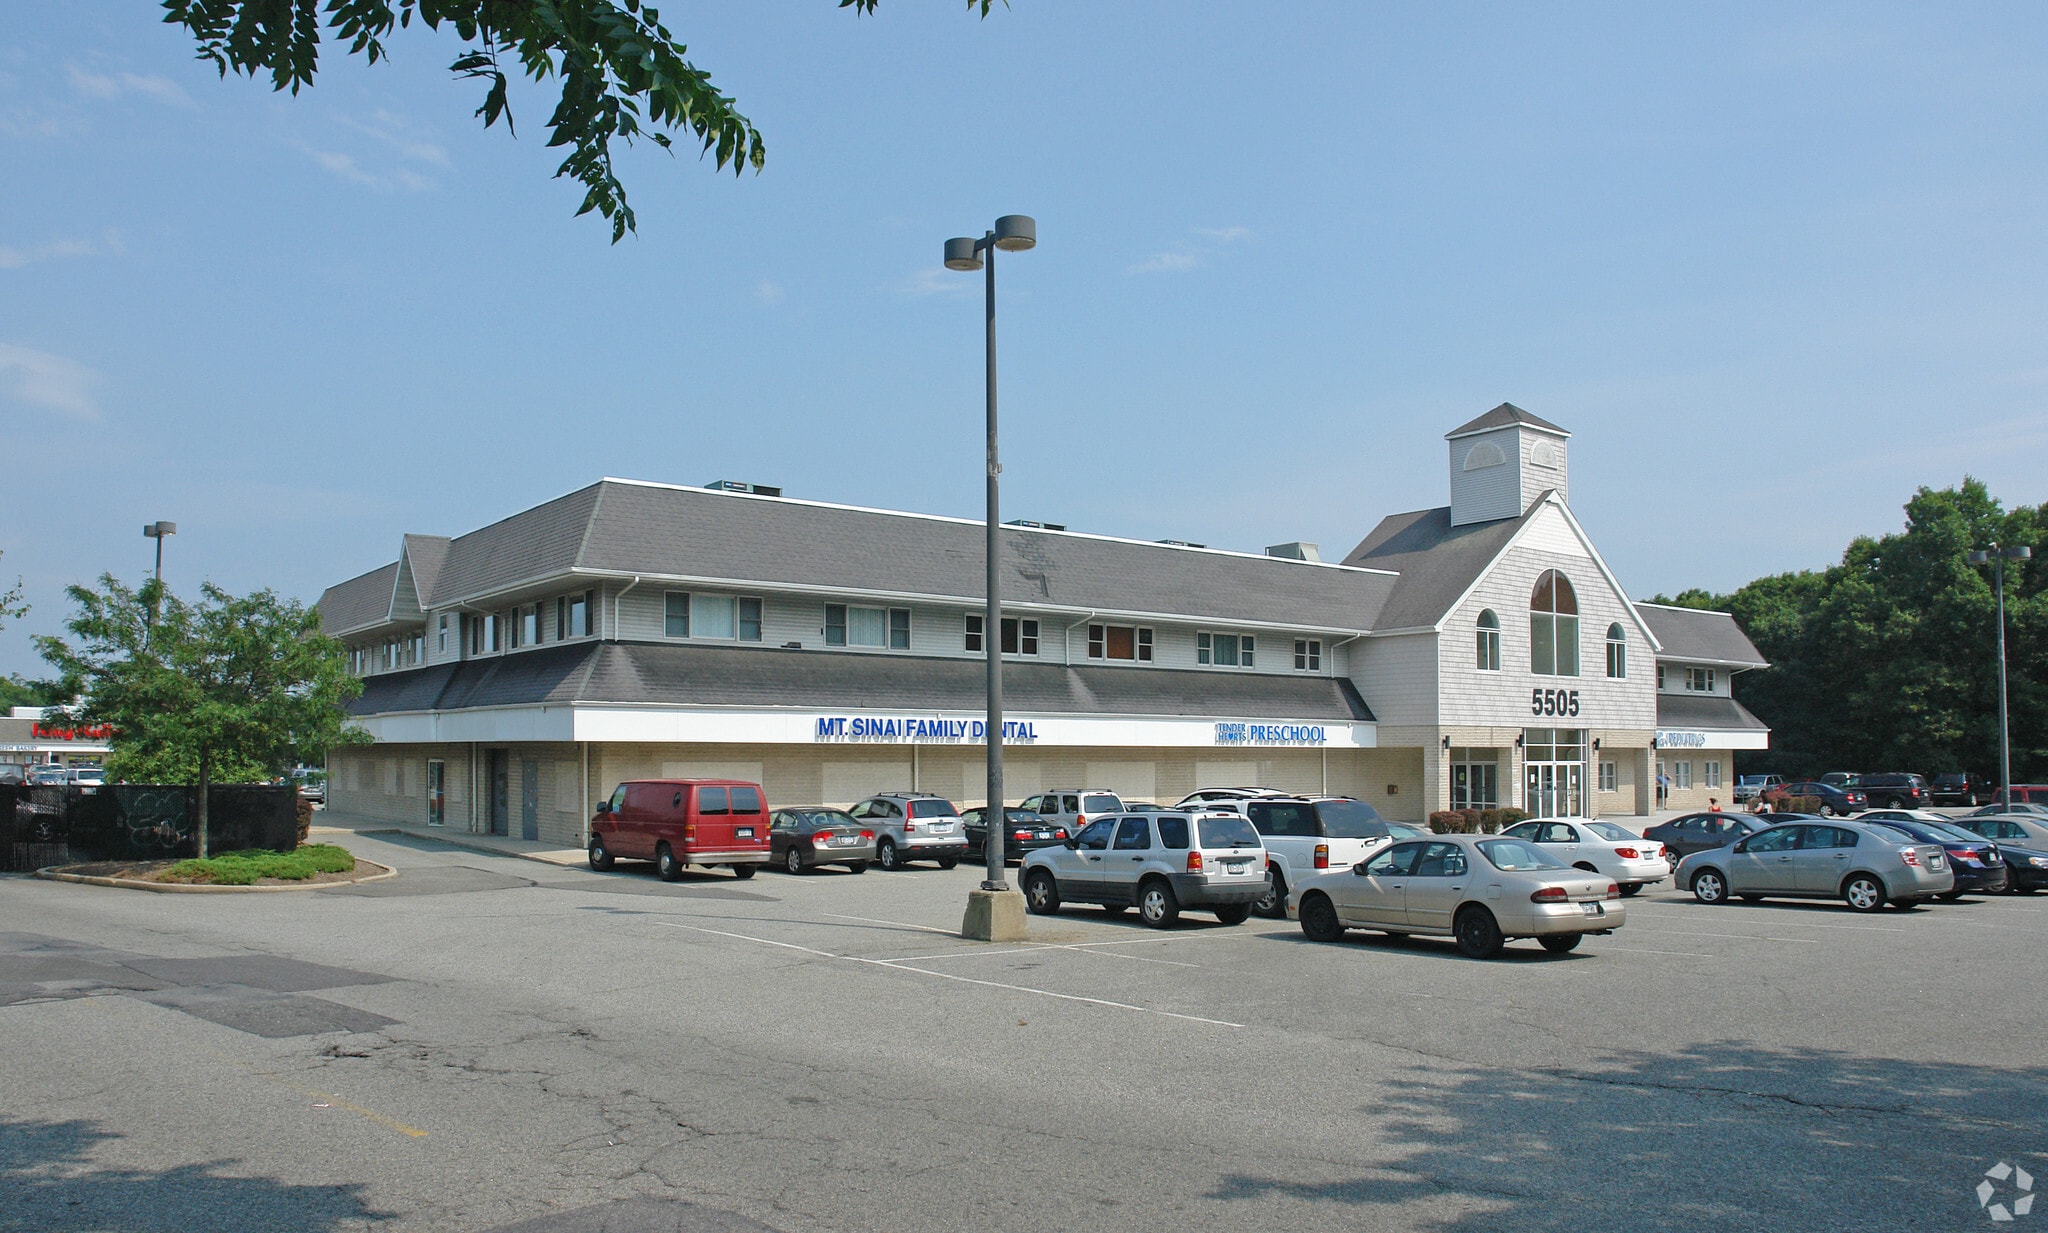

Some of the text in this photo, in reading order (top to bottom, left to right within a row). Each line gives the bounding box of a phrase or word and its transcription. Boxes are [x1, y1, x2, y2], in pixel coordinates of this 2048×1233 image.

[1532, 688, 1579, 717] 5505
[818, 717, 1038, 739] MT. SINAI FAMILY DTAL
[1217, 722, 1246, 732] TENDER
[1250, 724, 1327, 742] PRESCHOOL
